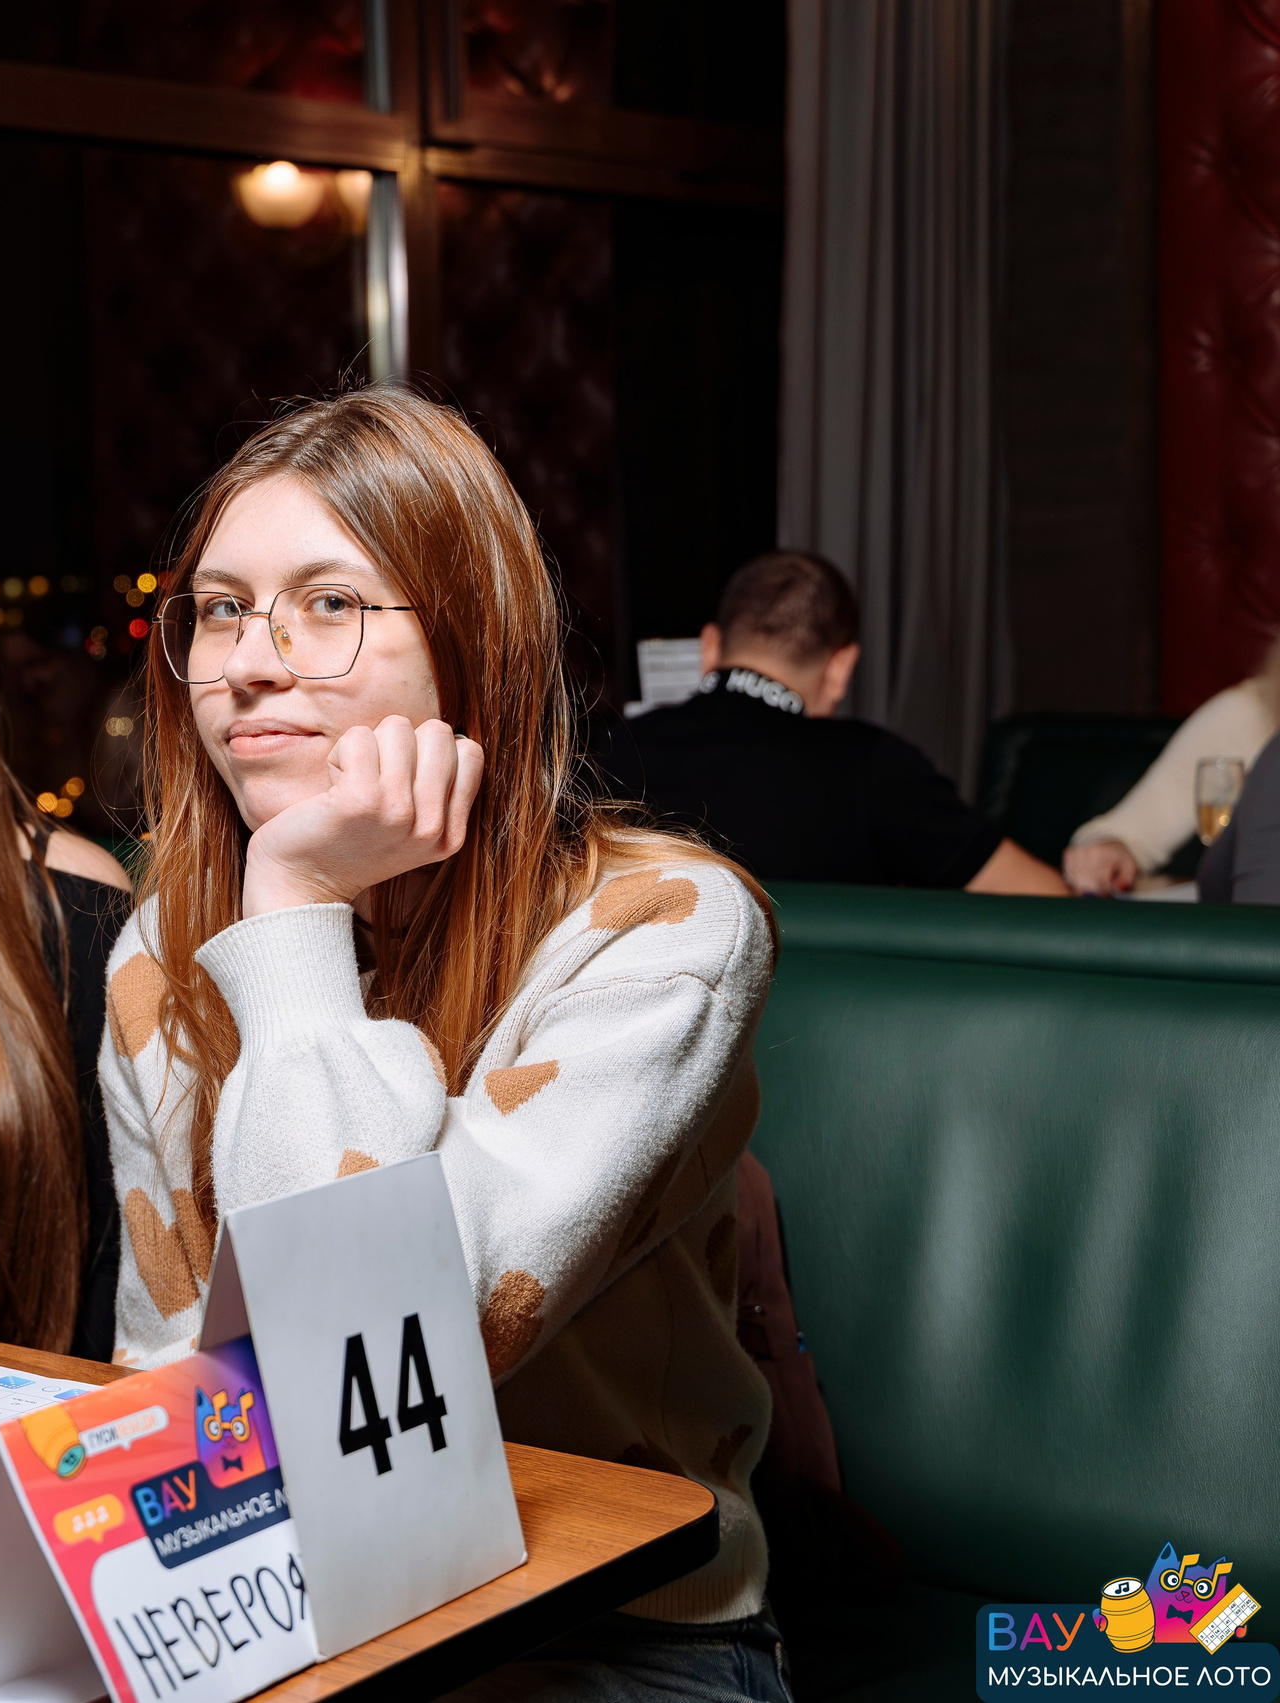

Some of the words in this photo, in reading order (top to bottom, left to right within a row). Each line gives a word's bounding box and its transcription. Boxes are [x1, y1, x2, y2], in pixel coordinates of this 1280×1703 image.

[337, 1312, 448, 1477] 44
[134, 1469, 197, 1526] ВАУ
[154, 1492, 277, 1558] МУЗЫКАЛЬНОЕ
